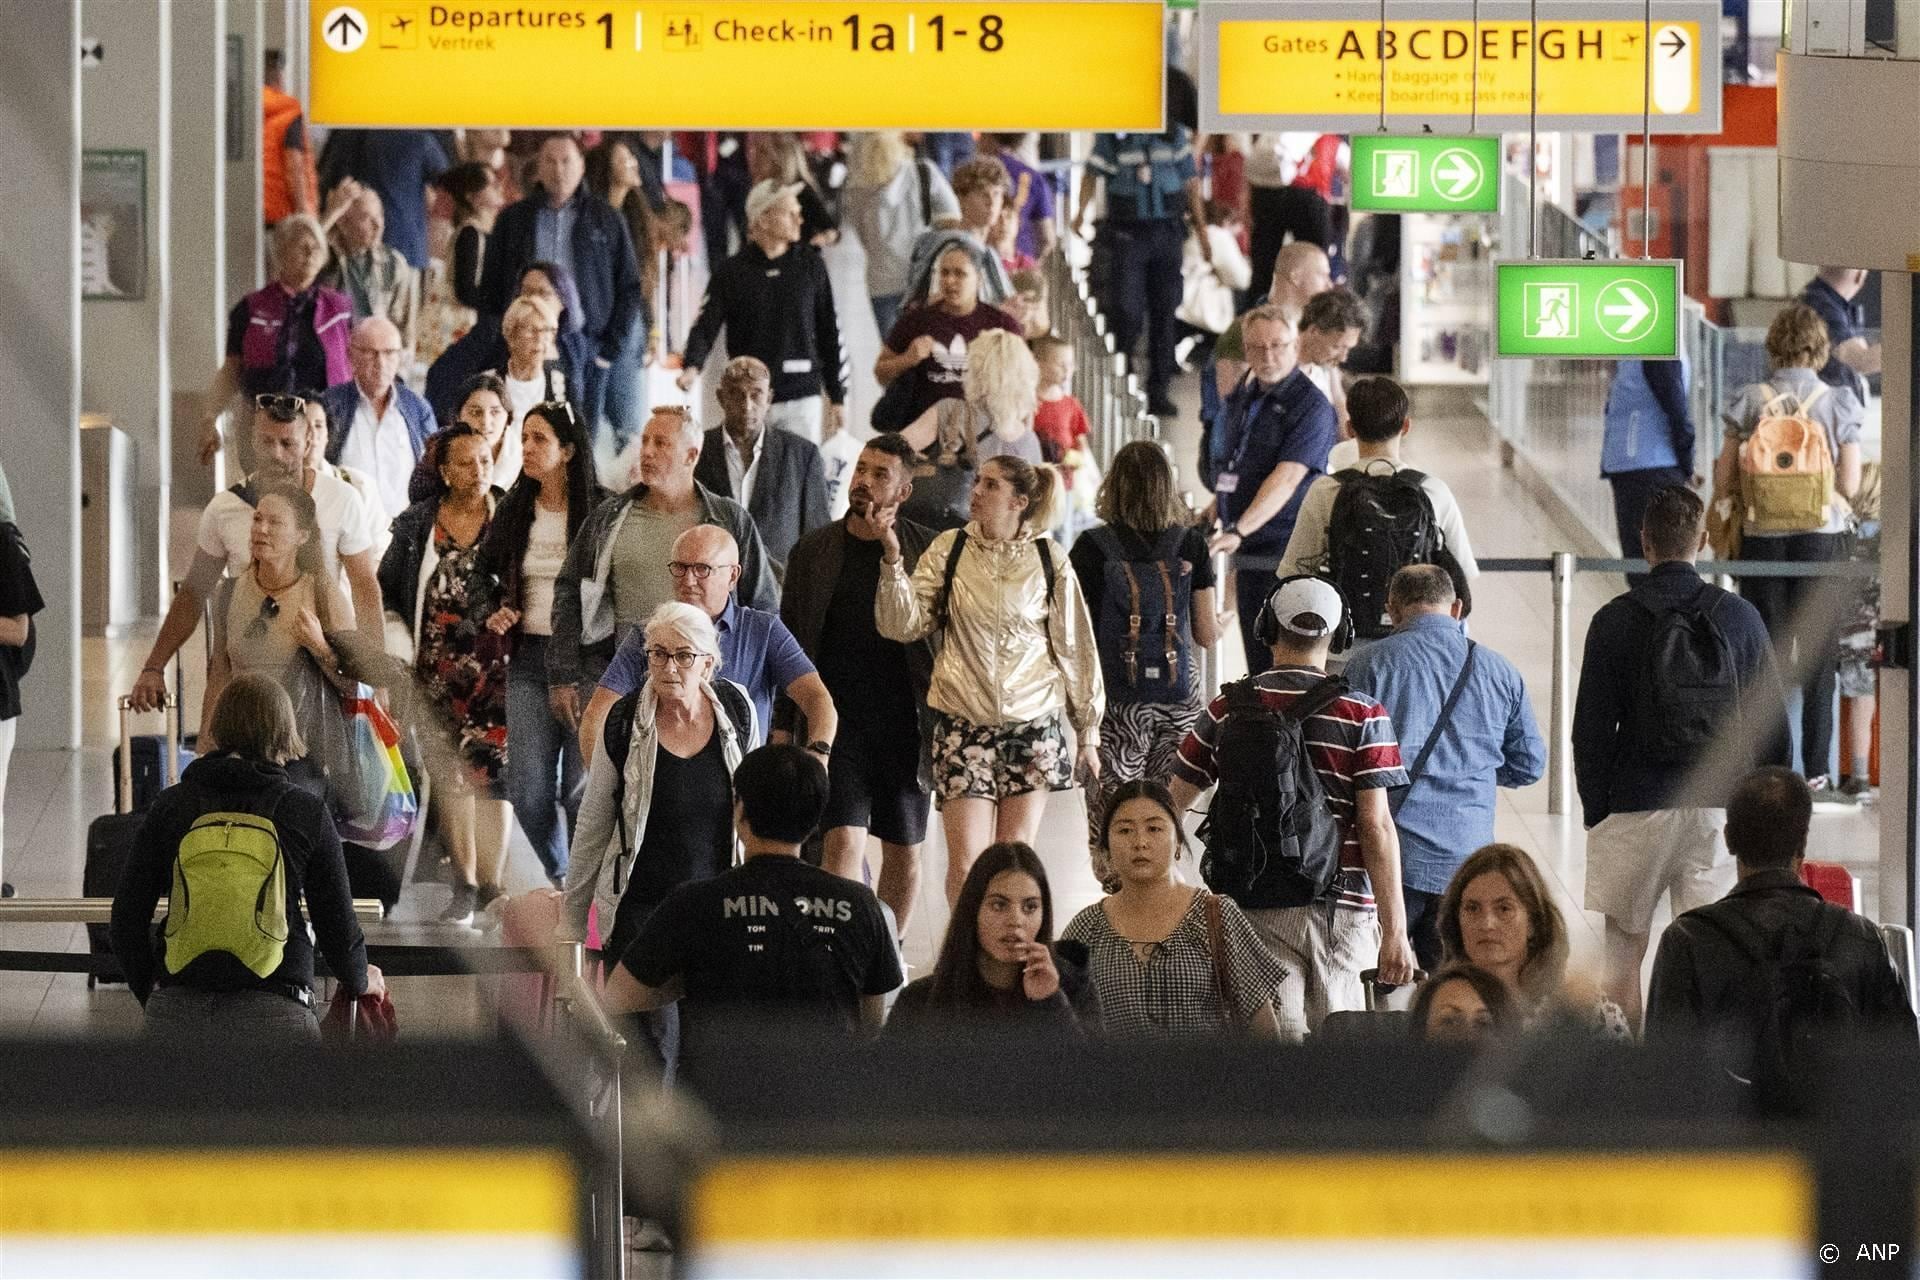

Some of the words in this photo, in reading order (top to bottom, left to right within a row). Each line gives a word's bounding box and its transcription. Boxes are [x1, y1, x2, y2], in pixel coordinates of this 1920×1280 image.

[431, 6, 586, 31] Departures
[596, 12, 613, 50] 1
[714, 19, 833, 42] Check-in
[843, 14, 895, 52] 1a
[428, 35, 496, 51] Vertrek
[1263, 35, 1329, 53] Gates
[1391, 70, 1458, 87] baggage
[1391, 89, 1459, 106] boarding
[747, 925, 766, 934] TOM
